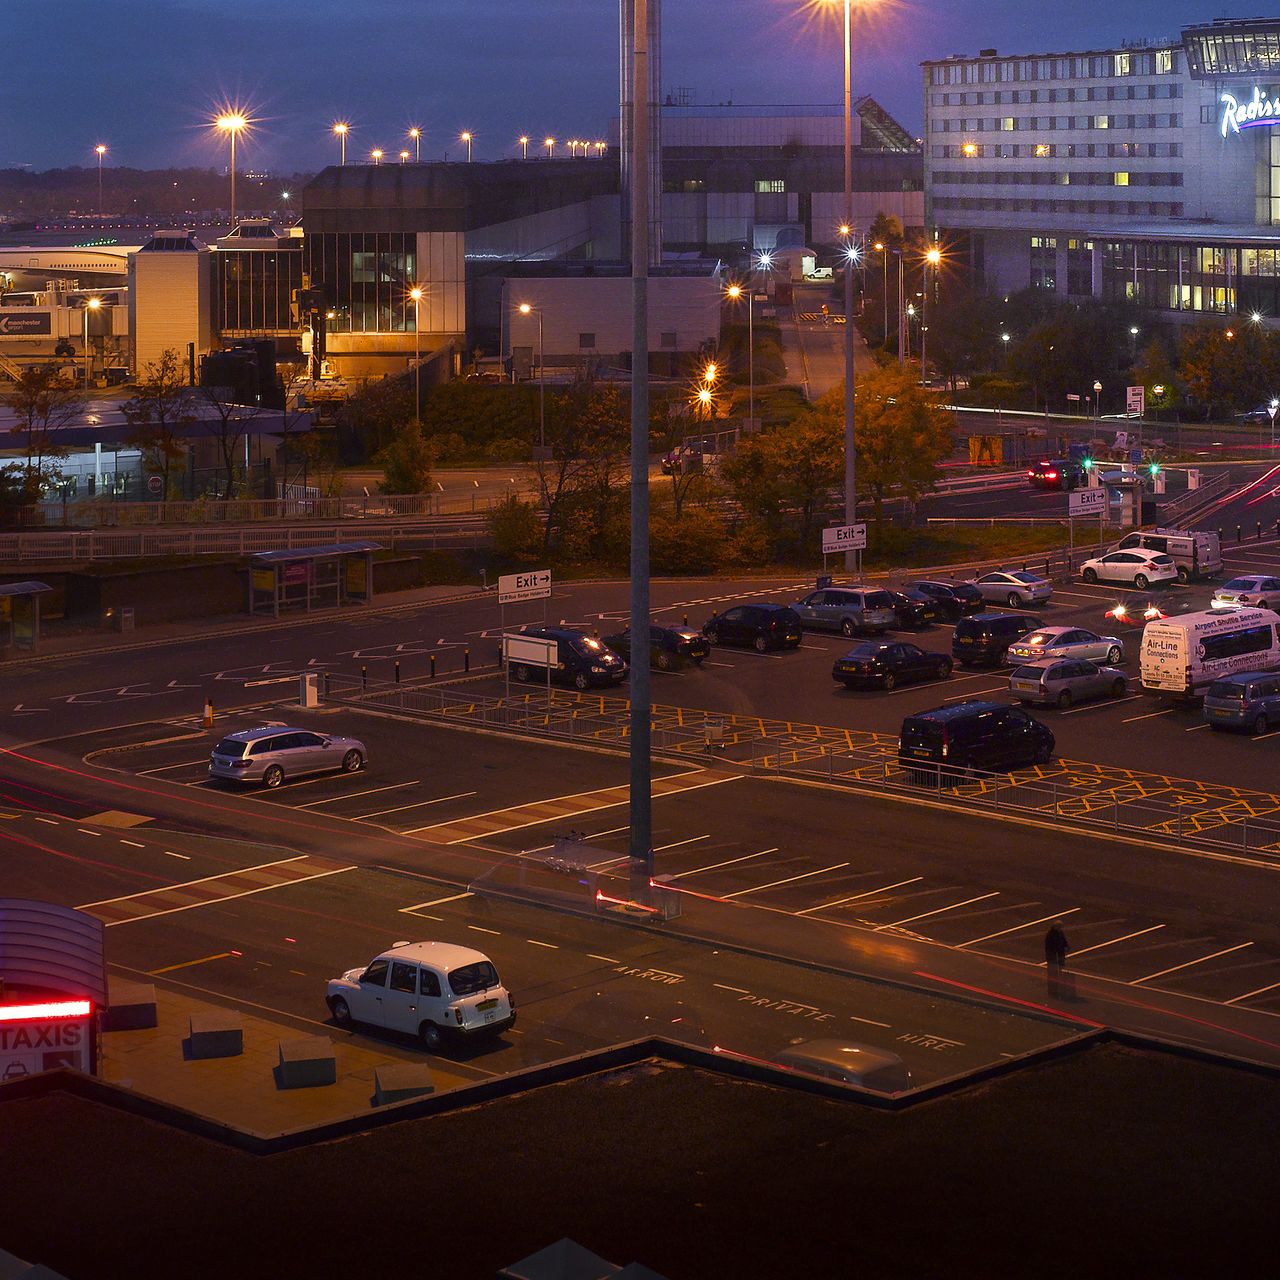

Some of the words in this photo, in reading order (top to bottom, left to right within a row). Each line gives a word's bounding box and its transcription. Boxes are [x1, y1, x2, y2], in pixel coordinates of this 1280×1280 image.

[1081, 492, 1096, 504] Exit
[837, 528, 855, 540] Exit
[516, 575, 537, 588] Exit
[1195, 620, 1216, 630] Airport
[1217, 617, 1239, 626] Shuttle
[1240, 613, 1263, 621] Service
[1147, 639, 1178, 651] Air-Line
[1147, 649, 1179, 659] Connections
[1228, 652, 1268, 667] Connections
[613, 966, 686, 985] ARROW
[738, 994, 837, 1022] PRIVATE
[897, 1033, 956, 1052] HIRE
